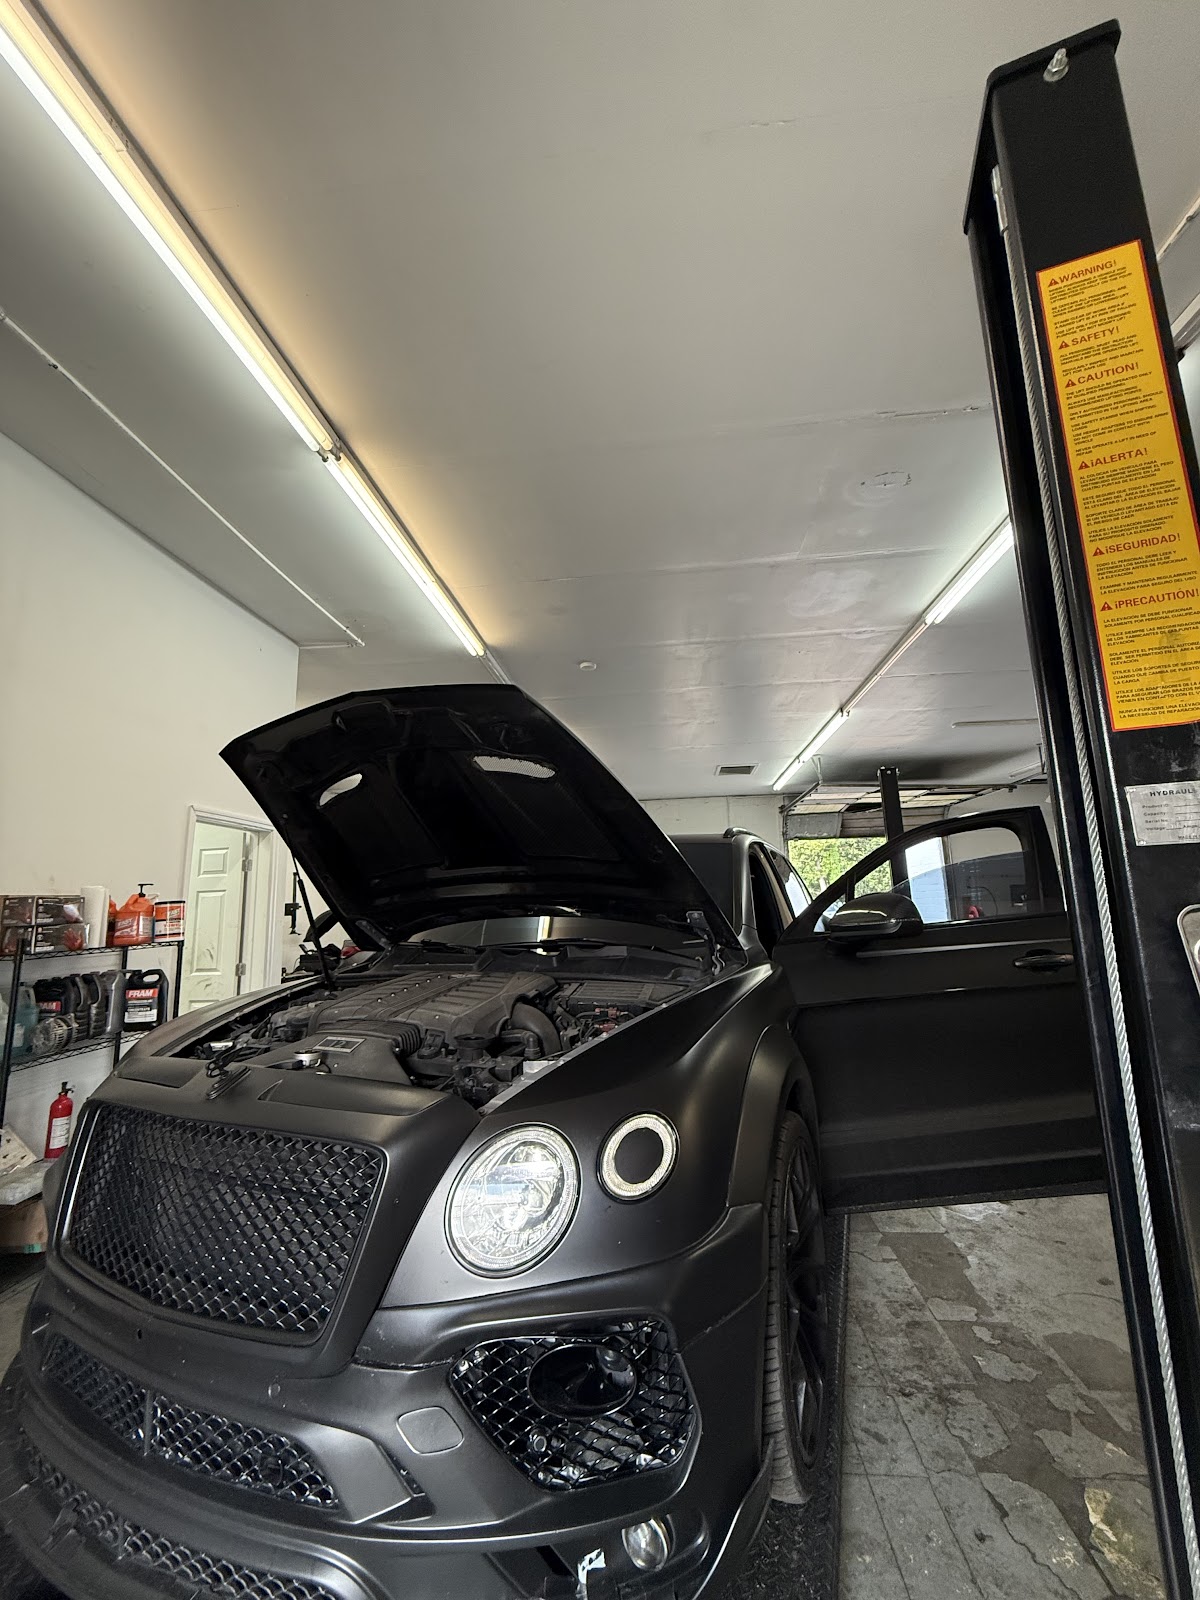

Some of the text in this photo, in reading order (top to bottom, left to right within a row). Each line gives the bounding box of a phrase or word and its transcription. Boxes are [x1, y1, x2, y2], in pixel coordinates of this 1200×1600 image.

[1059, 260, 1117, 283] WARNING!
[1071, 326, 1120, 346] SAFETY!
[1077, 362, 1139, 385] CAUTION!
[1149, 788, 1195, 796] HYDRAUL
[128, 990, 154, 999] FRAM
[39, 1002, 57, 1011] RAM
